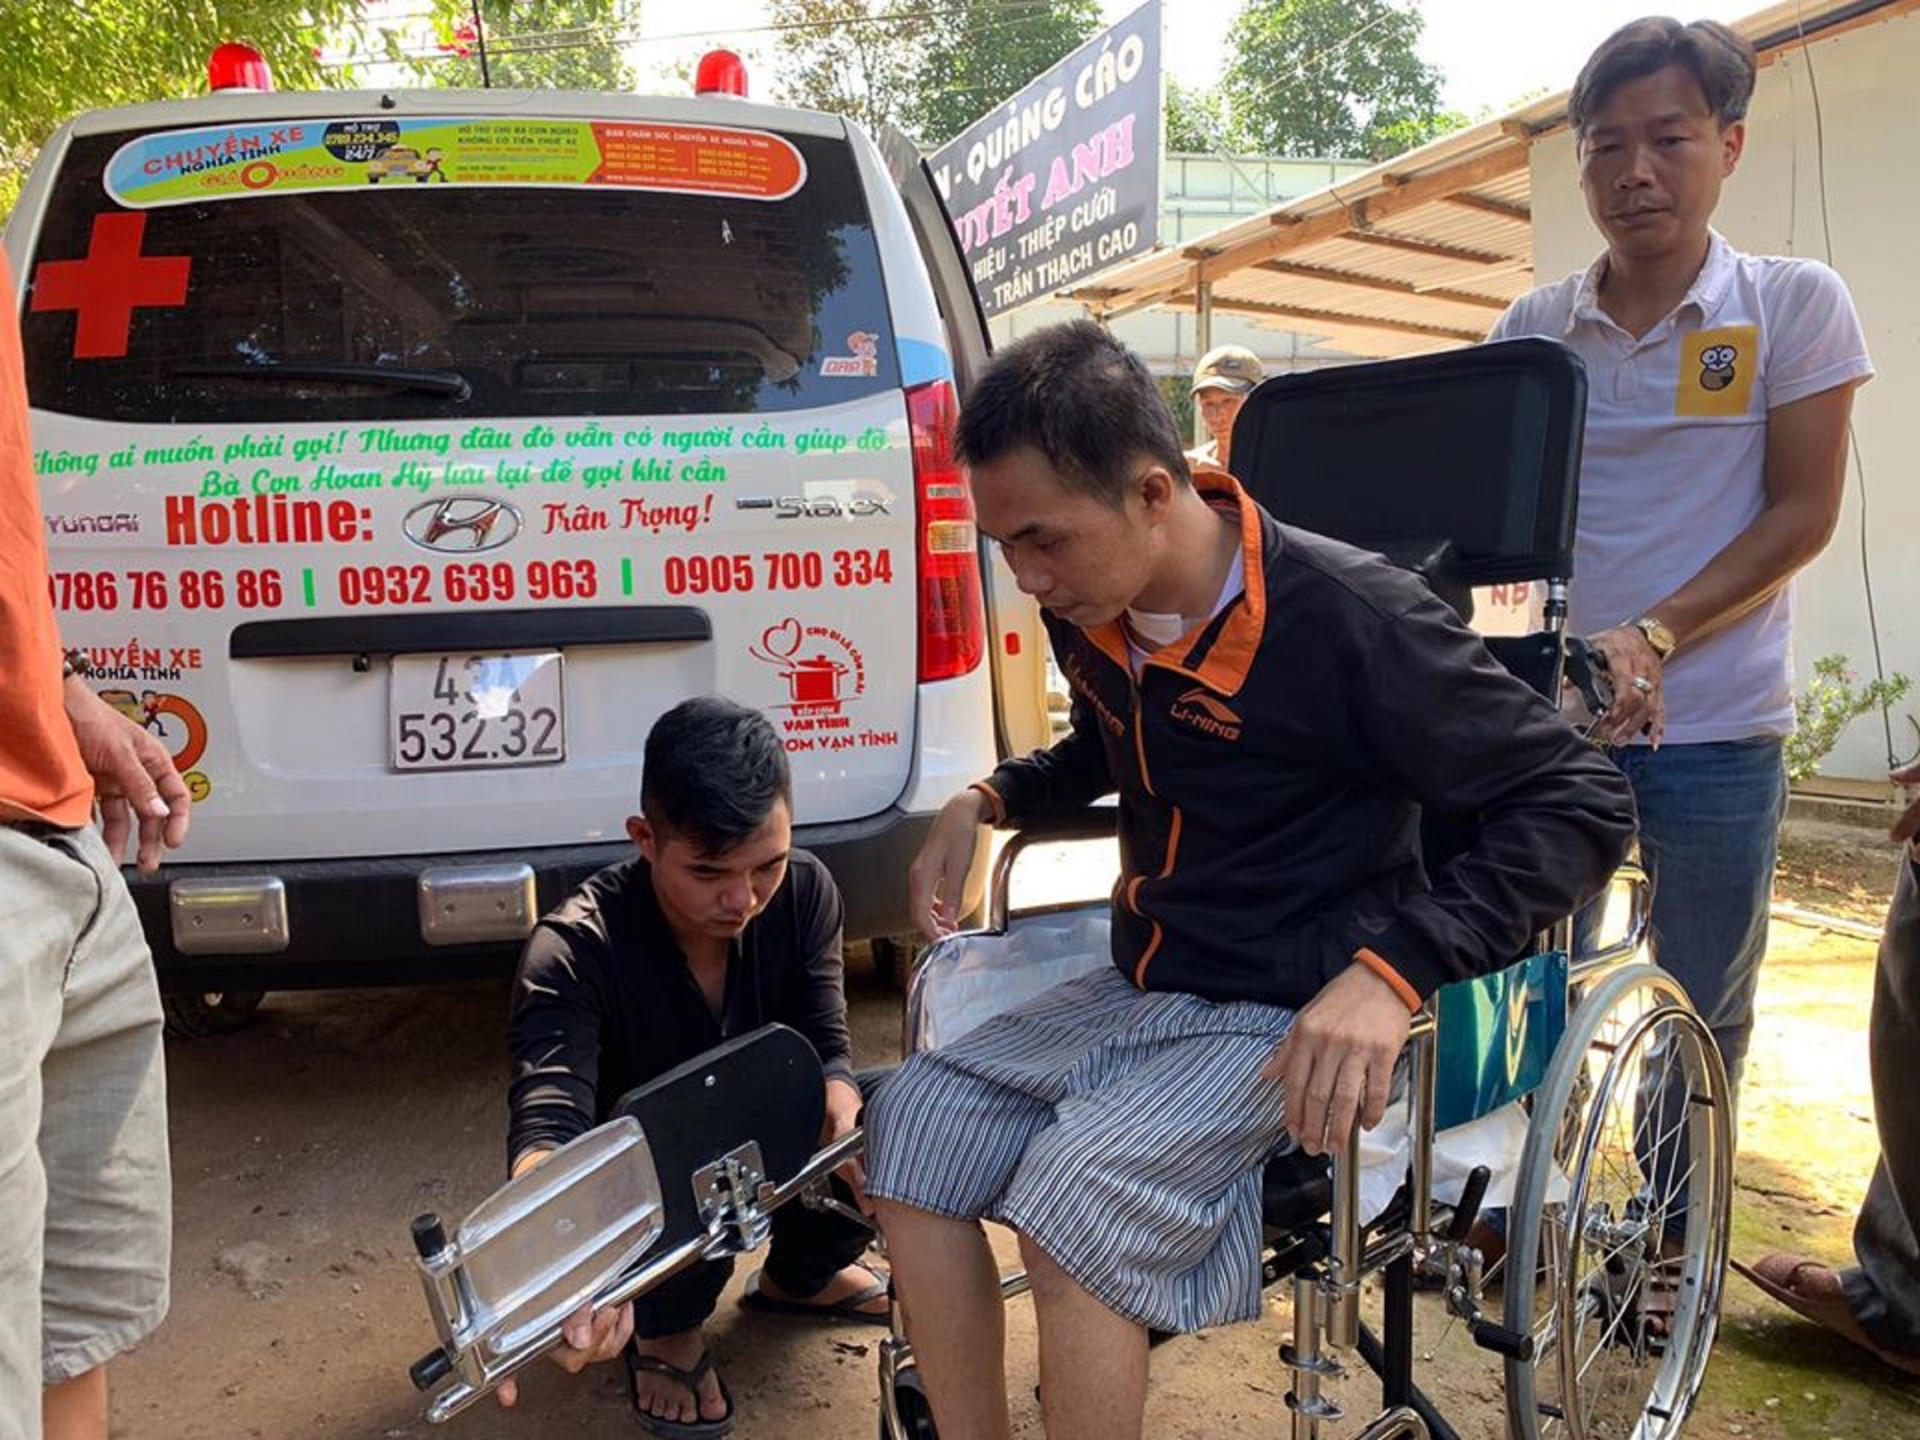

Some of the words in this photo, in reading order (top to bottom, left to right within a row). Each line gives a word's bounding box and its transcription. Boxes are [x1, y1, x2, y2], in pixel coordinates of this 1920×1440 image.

[967, 87, 1066, 185] QUẢNG
[1075, 34, 1143, 109] CÁO
[271, 127, 304, 145] XE
[1041, 114, 1136, 210] ANH
[1018, 217, 1066, 260] THIỆP
[993, 262, 1034, 309] TRẦN
[1036, 238, 1093, 288] THẠCH
[1098, 222, 1137, 260] CAO
[109, 445, 136, 468] ai
[144, 435, 214, 465] muốn
[223, 434, 285, 464] phải
[292, 429, 349, 462] gọi!
[359, 428, 450, 456] Nhưng
[461, 426, 512, 449] đâu
[523, 424, 555, 448] đó
[565, 421, 614, 447] vẫn
[624, 426, 653, 447] có
[663, 426, 734, 453] người
[742, 421, 786, 448] cần
[795, 428, 847, 454] giúp
[200, 470, 241, 497] Bà
[252, 469, 300, 494] Con
[310, 464, 382, 490] Hoan
[495, 458, 531, 489] lại
[541, 455, 575, 482] để
[582, 459, 624, 488] gọi
[632, 457, 672, 482] khi
[680, 454, 726, 482] cần
[45, 514, 140, 534] YUNDAI
[166, 494, 373, 545] Hotline:
[542, 503, 608, 534] Trân
[620, 495, 715, 533] Trọng!
[127, 570, 168, 610] 76
[180, 569, 224, 609] 86
[236, 568, 283, 608] 86
[339, 565, 432, 605] 0932
[444, 562, 514, 602] 639
[527, 560, 597, 600] 963
[665, 554, 754, 595] 0905
[764, 552, 822, 590] 700
[833, 549, 893, 587] 334
[171, 648, 203, 669] XE
[399, 707, 558, 763] 532.32
[818, 735, 854, 752] VẠN
[860, 729, 897, 746] TÌNH
[1170, 702, 1241, 741] LI-NING
